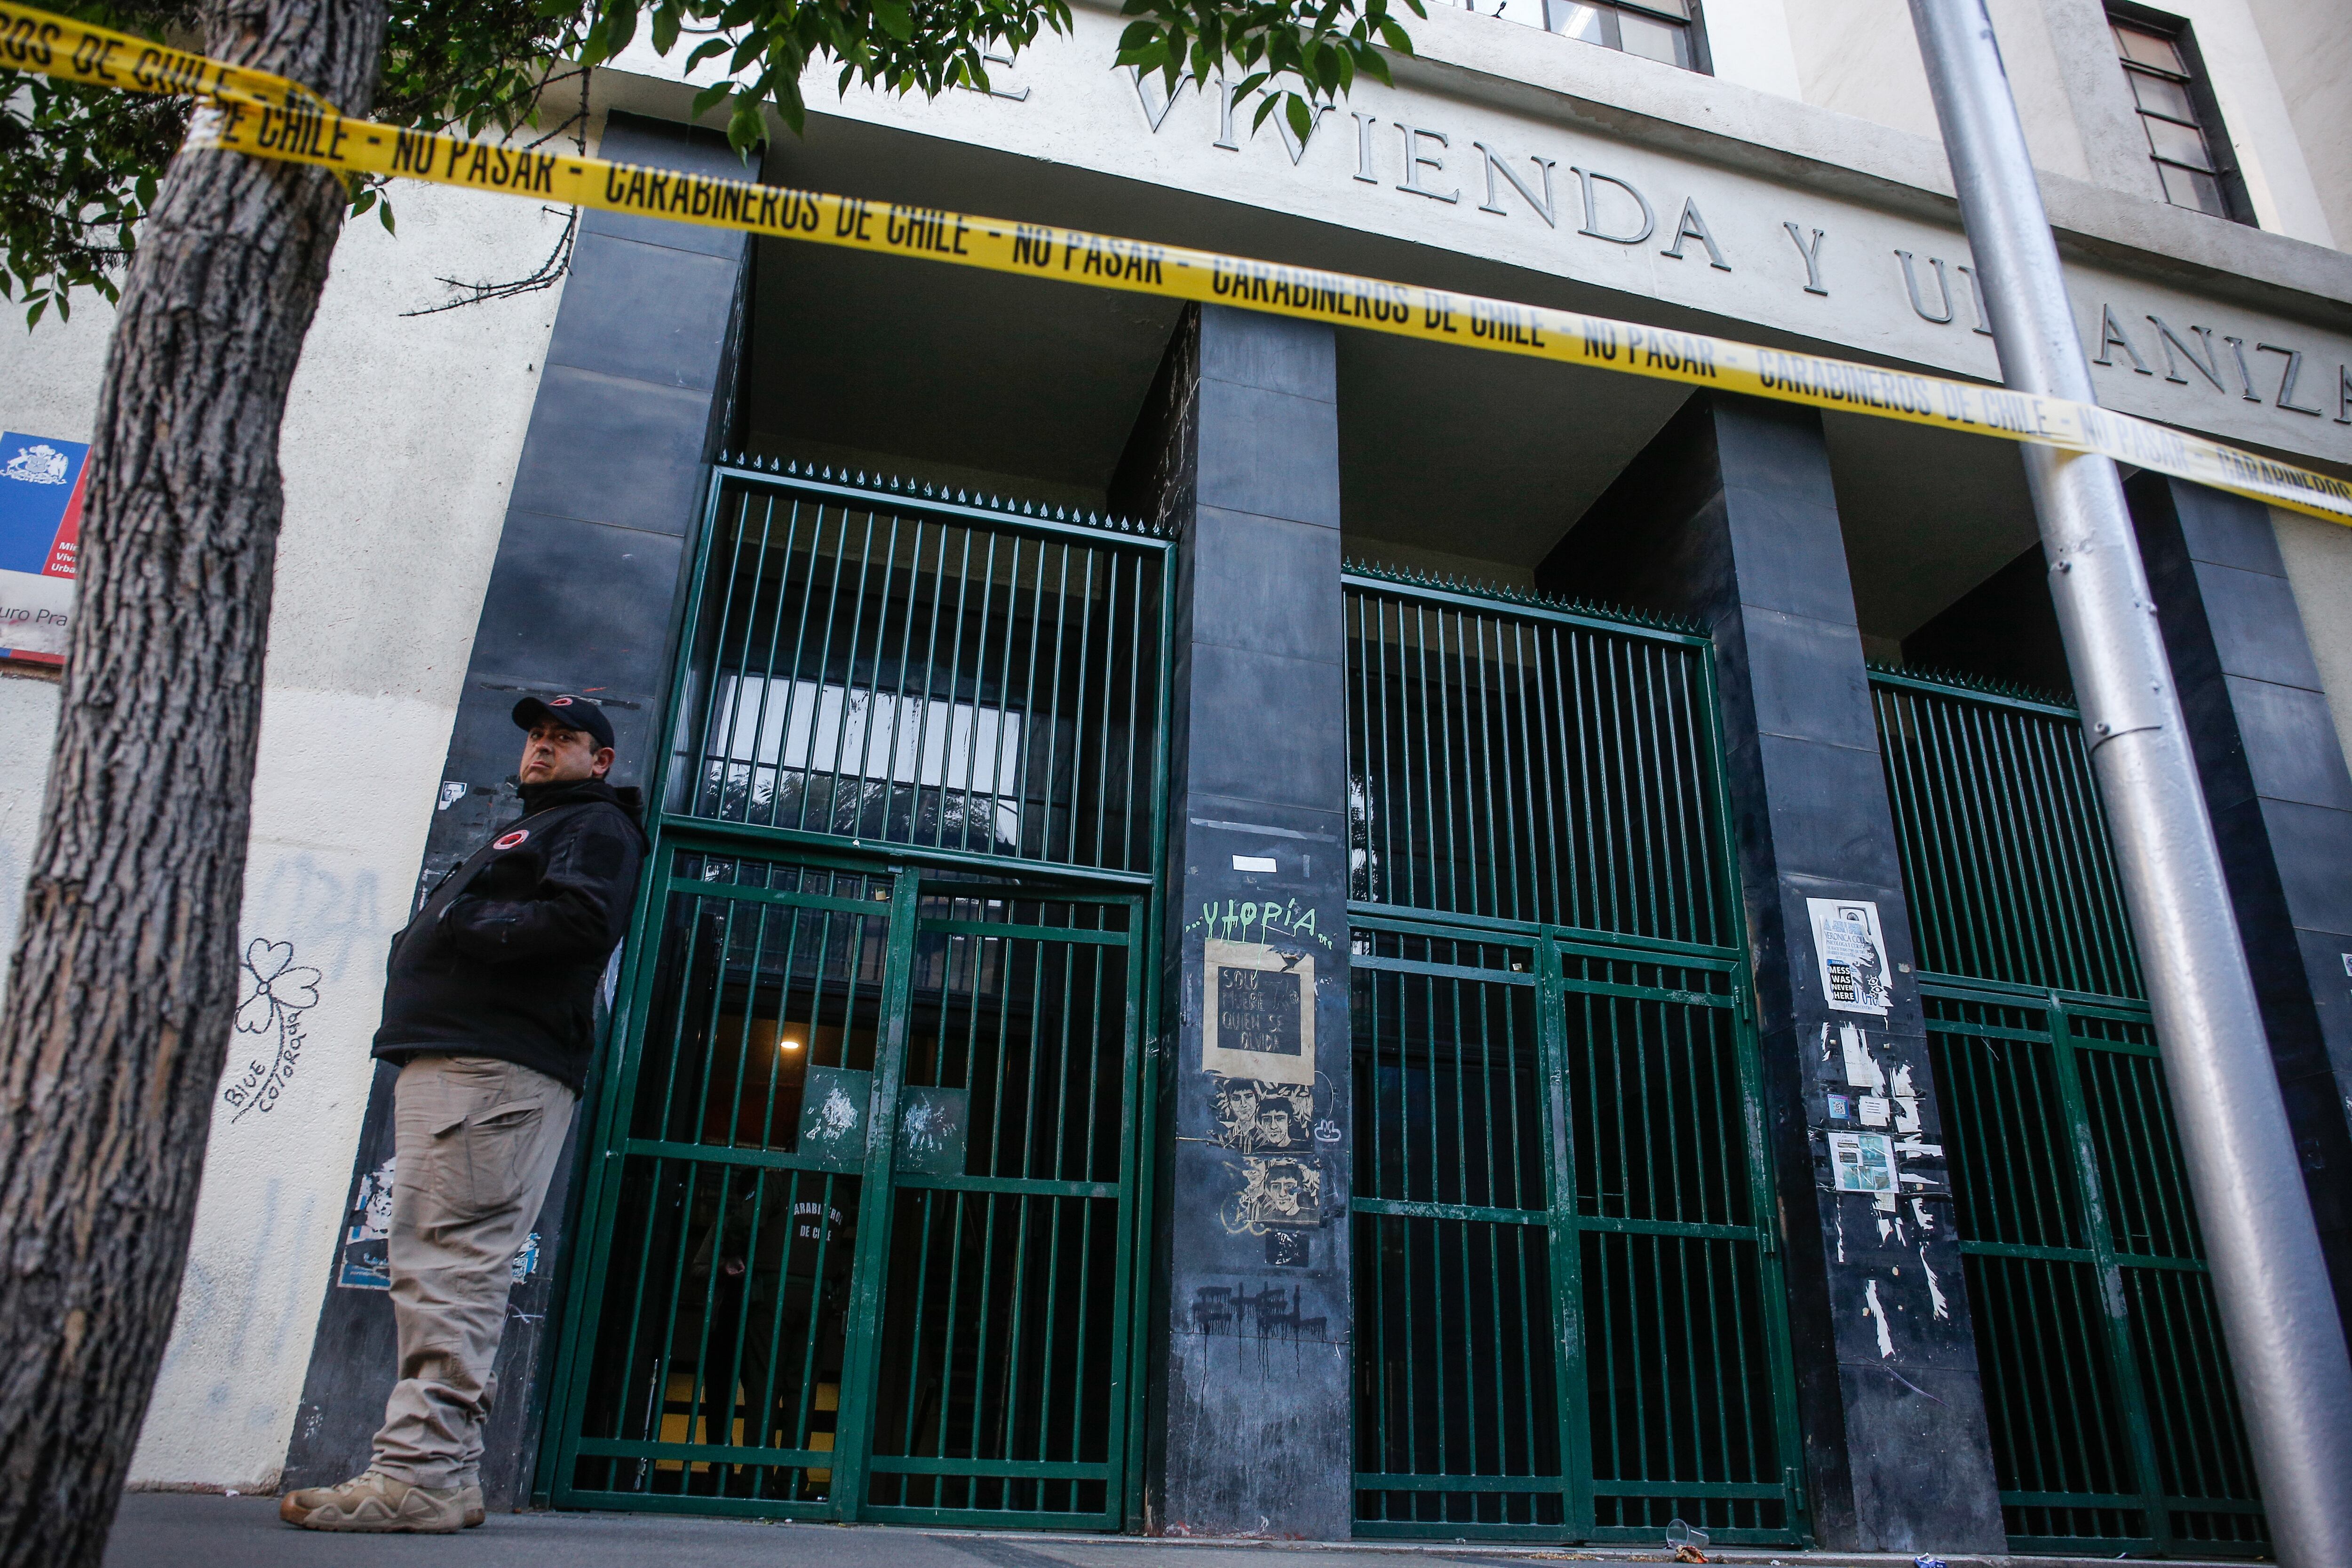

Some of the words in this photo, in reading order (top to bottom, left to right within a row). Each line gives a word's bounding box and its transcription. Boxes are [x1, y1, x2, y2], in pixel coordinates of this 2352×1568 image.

[73, 33, 123, 80] DE
[132, 48, 237, 95] CHILE
[1129, 64, 1732, 272] VIVIENDA
[1783, 222, 1828, 296] Y
[1894, 249, 2352, 425] UANIZ
[223, 101, 245, 142] E
[258, 105, 349, 161] CHILE
[392, 127, 436, 174] NO
[447, 135, 556, 194] PASAR
[605, 161, 823, 232] CARABINEROS
[835, 197, 877, 241] DE
[887, 203, 971, 255] CHILE
[1013, 223, 1054, 268] NO
[1064, 228, 1165, 285] PASAR
[1212, 254, 1410, 324] CARABINEROS
[1424, 290, 1457, 333] DE
[1470, 298, 1546, 349] CHILE
[1582, 317, 1617, 361] NO
[1627, 324, 1717, 378] PASAR
[1755, 349, 1932, 417] CARABINEROS
[1939, 382, 1975, 423] DE
[1980, 389, 2051, 438] CHILE
[2077, 404, 2113, 450] NO
[2119, 417, 2190, 470] PASAR
[51, 563, 77, 573] Urba
[1829, 966, 1851, 975] MESS
[1831, 975, 1851, 984] WAS
[1834, 992, 1855, 1000] HERE
[800, 1225, 810, 1238] DE
